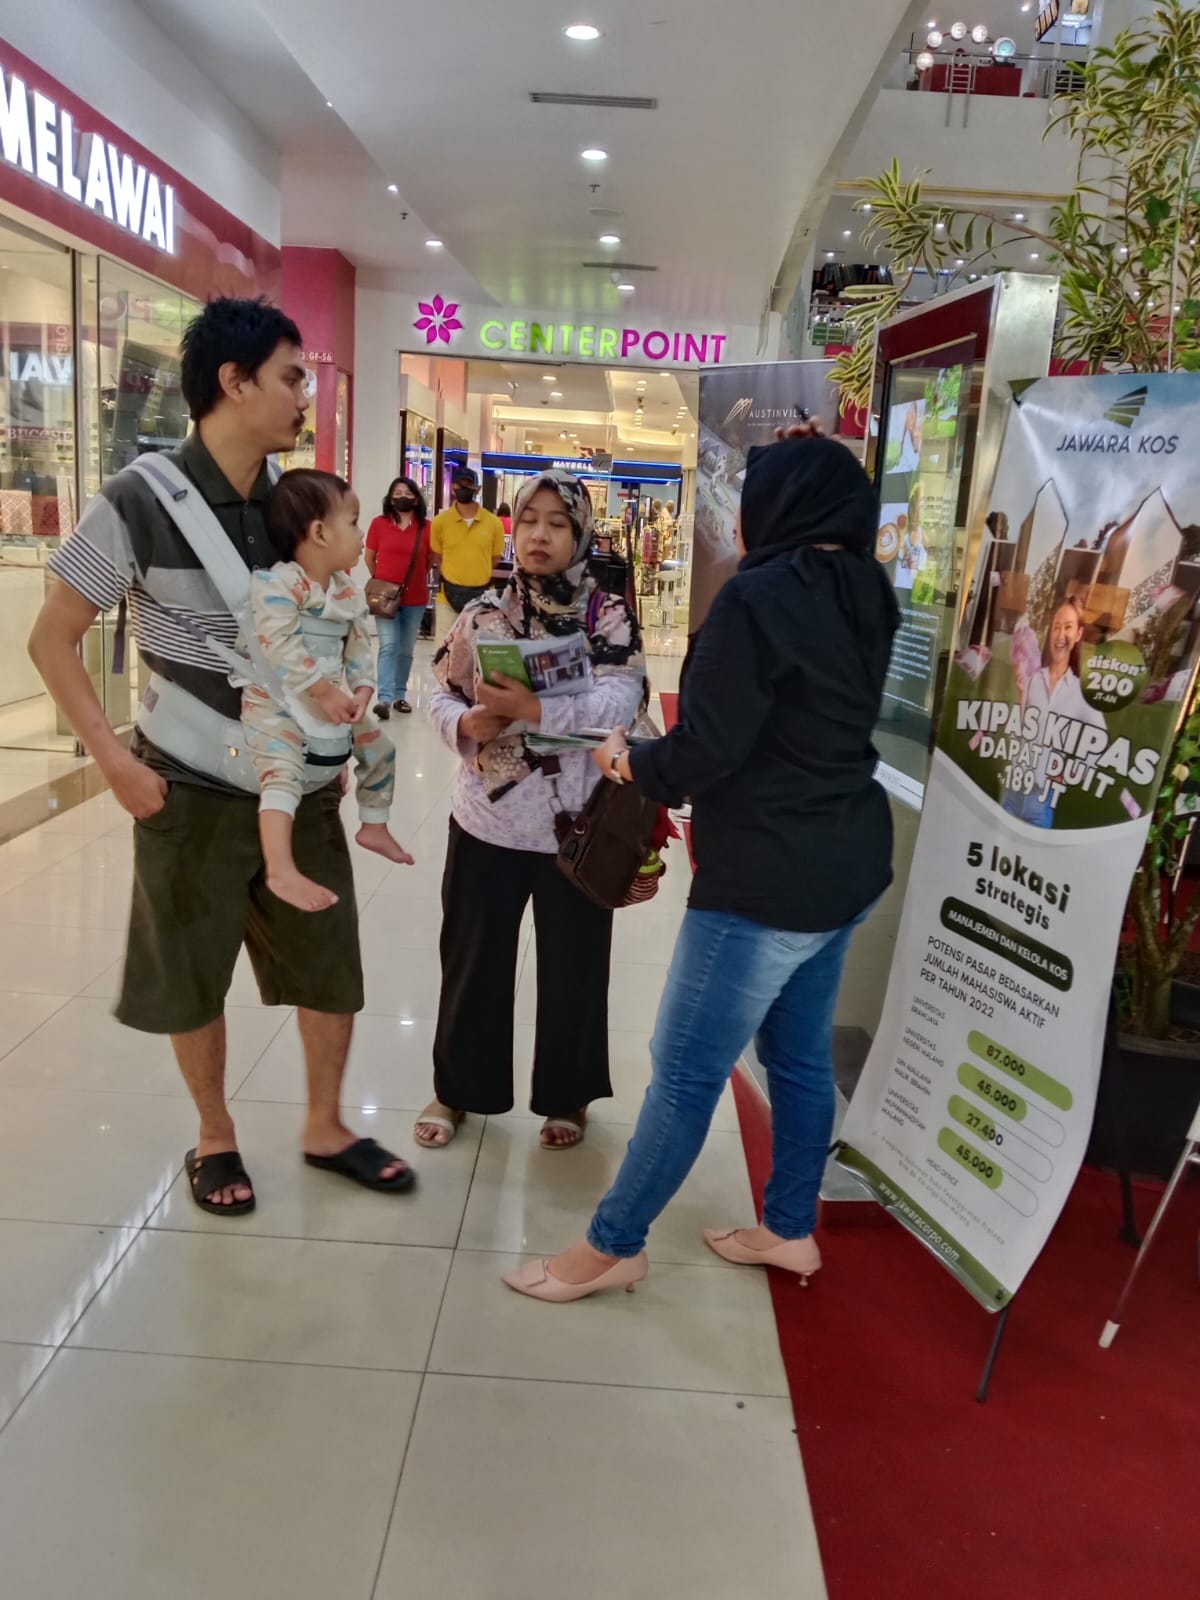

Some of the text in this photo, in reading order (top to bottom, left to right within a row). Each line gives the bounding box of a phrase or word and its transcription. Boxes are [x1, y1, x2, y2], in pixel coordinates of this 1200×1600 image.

[0, 64, 176, 256] MELAWAI
[479, 319, 727, 364] CENTERPOINT
[749, 407, 809, 419] AUSTINVILE
[1056, 434, 1179, 455] JAWARA KOS
[1086, 671, 1134, 697] 200
[956, 700, 1160, 786] KIPAS KIPAS
[979, 736, 1116, 799] DAPAT DUIT
[1038, 778, 1067, 809] JT
[966, 841, 1070, 914] 5 lokasi
[975, 877, 1050, 930] Strategis
[948, 910, 1069, 981] MANAJEMEN DAN KELOLA KOS
[920, 968, 994, 1018] PER TAHUN 2022
[924, 953, 1046, 1029] JUMLAH MAHASISWA AKTIF
[927, 935, 1060, 1018] POTENSI PASAR BEDASARKAN
[986, 1044, 1026, 1076] 87.000
[977, 1079, 1017, 1111] 45.000
[966, 1112, 1004, 1146] 27.400
[955, 1144, 994, 1178] 45.000
